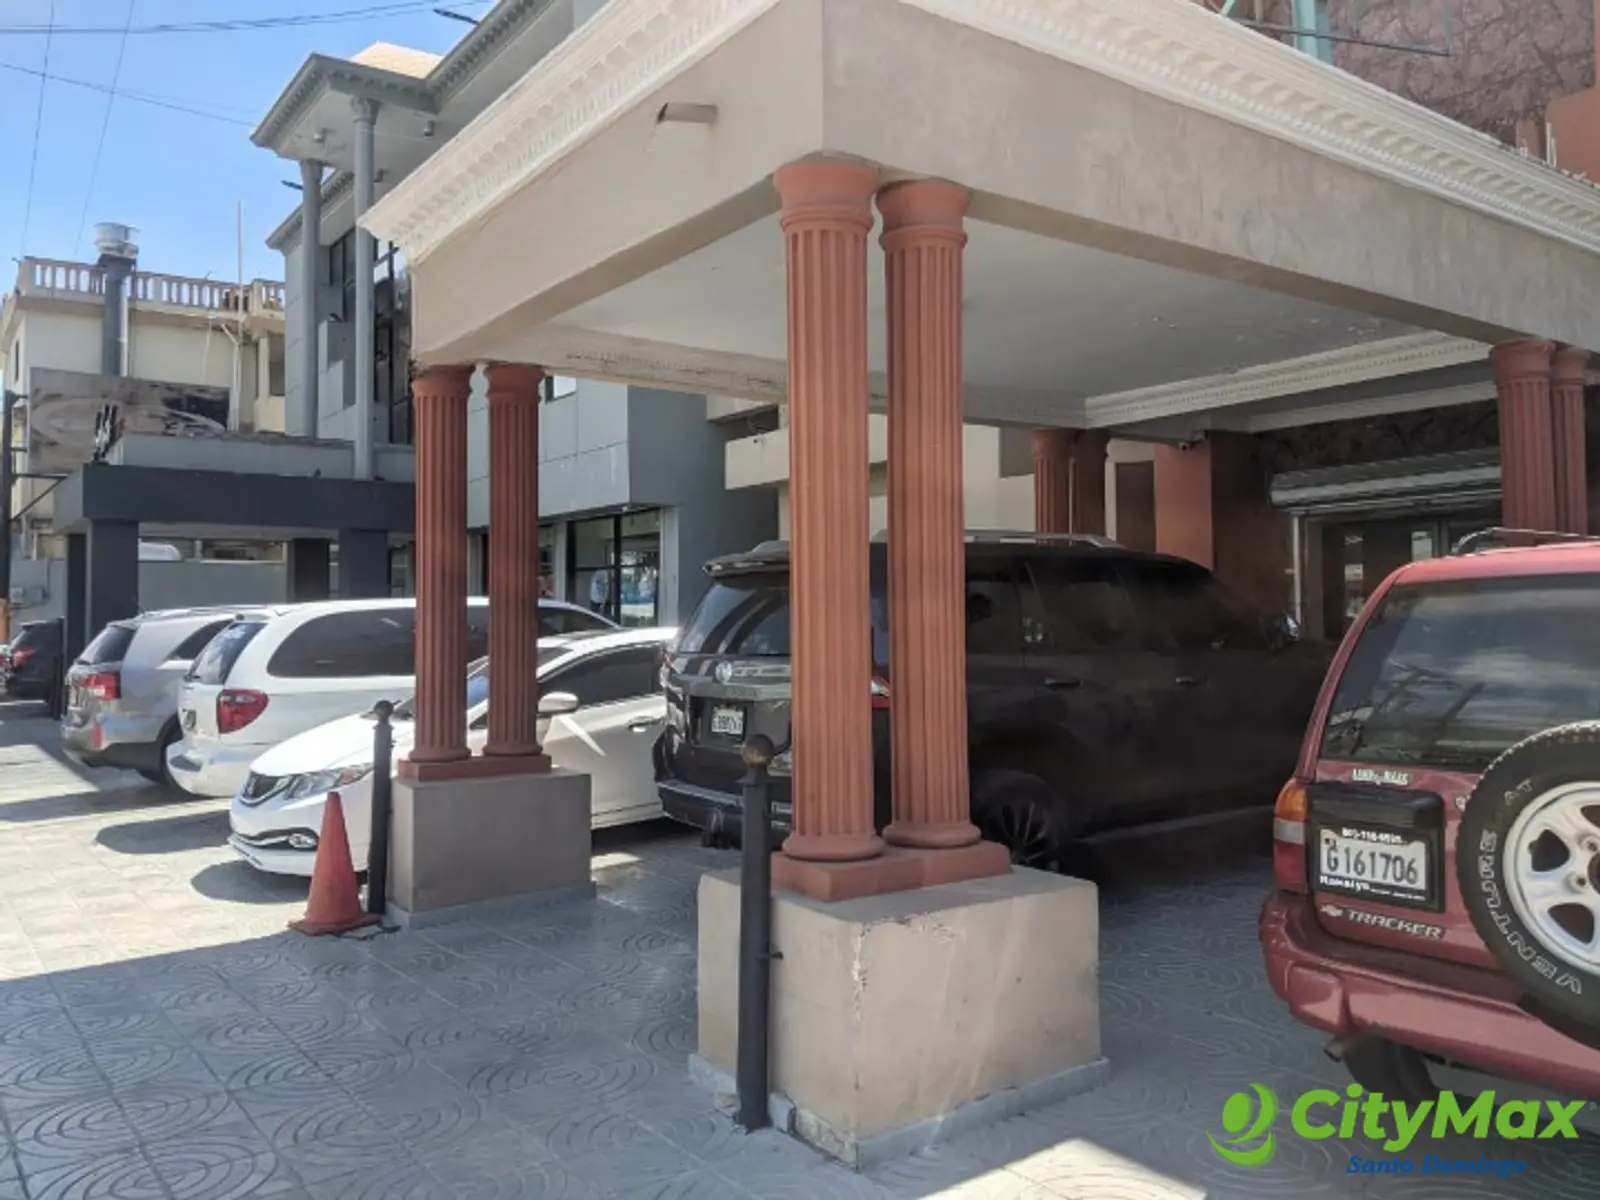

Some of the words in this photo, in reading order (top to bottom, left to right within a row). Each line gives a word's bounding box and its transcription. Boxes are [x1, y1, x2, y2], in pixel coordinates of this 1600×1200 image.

[1326, 846, 1419, 886] G161706
[1347, 909, 1442, 940] TRACKER
[1478, 829, 1582, 995] VENTURE
